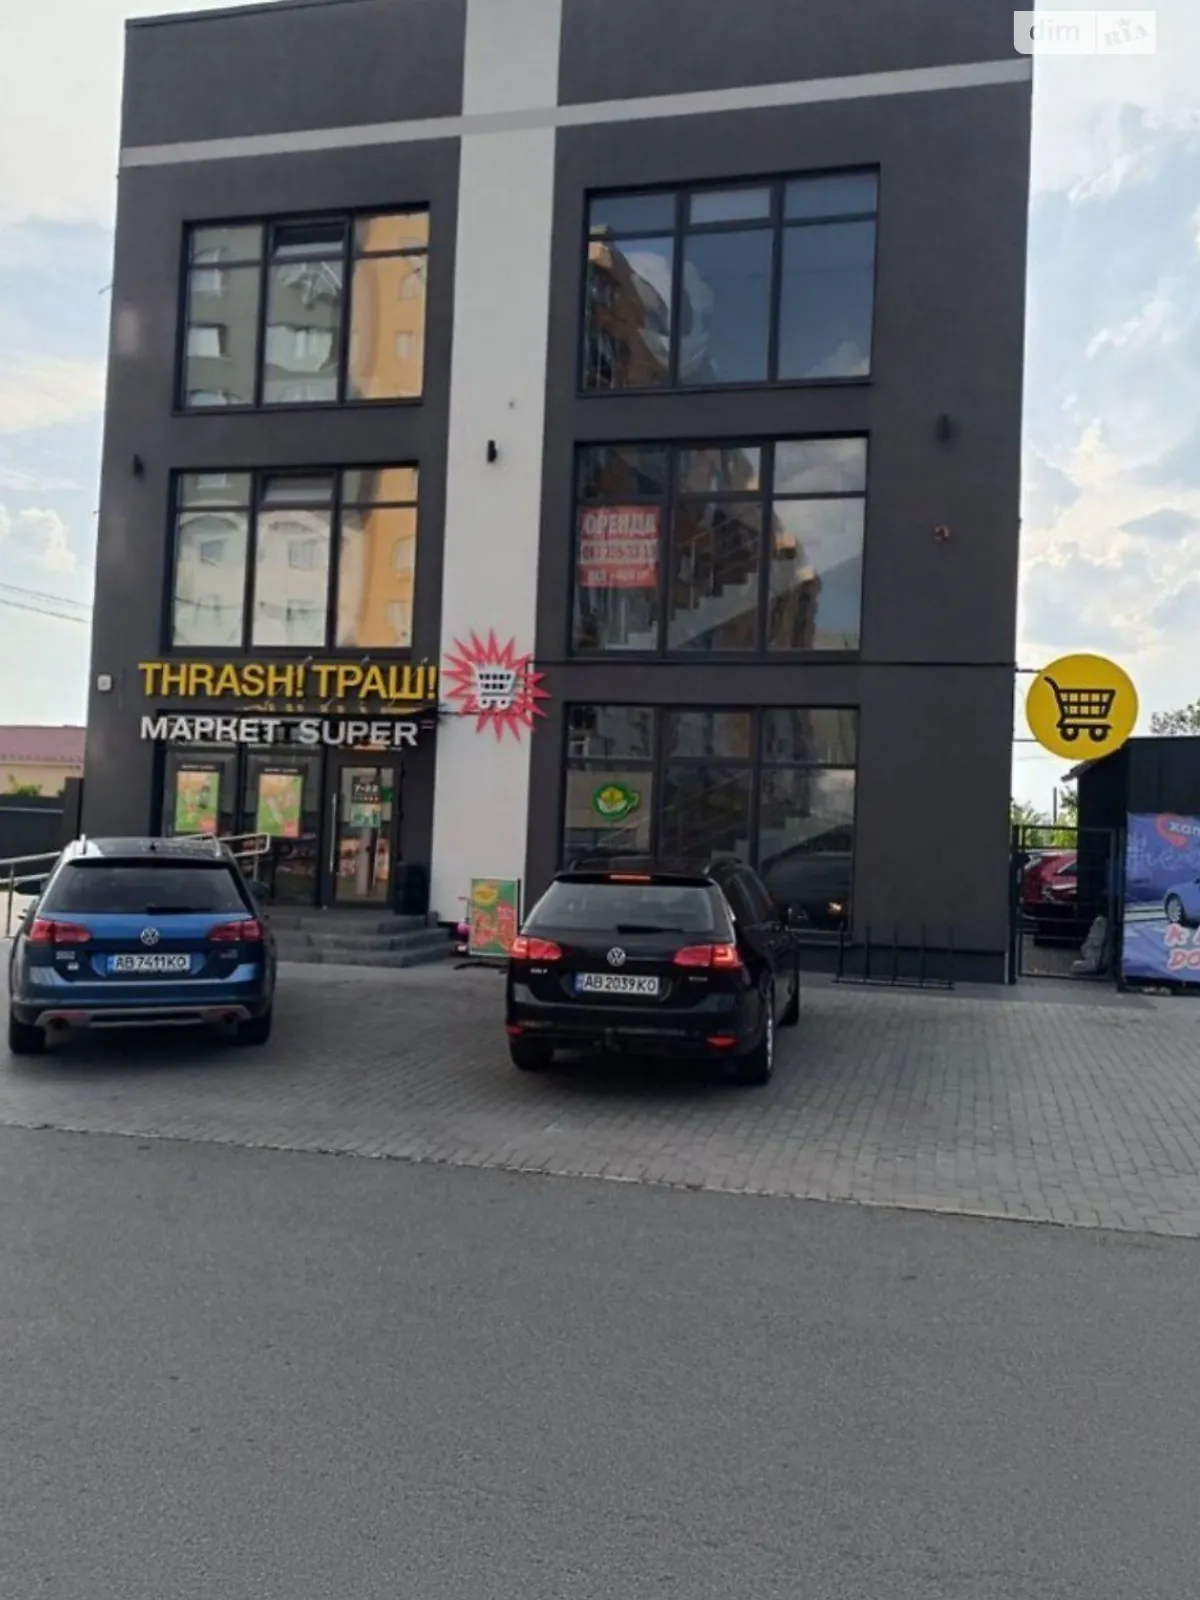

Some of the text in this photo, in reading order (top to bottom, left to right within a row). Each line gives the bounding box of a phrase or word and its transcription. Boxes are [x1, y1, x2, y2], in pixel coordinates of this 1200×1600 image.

[138, 662, 437, 700] THRASH! ТРАШ!
[299, 718, 418, 747] SUPER
